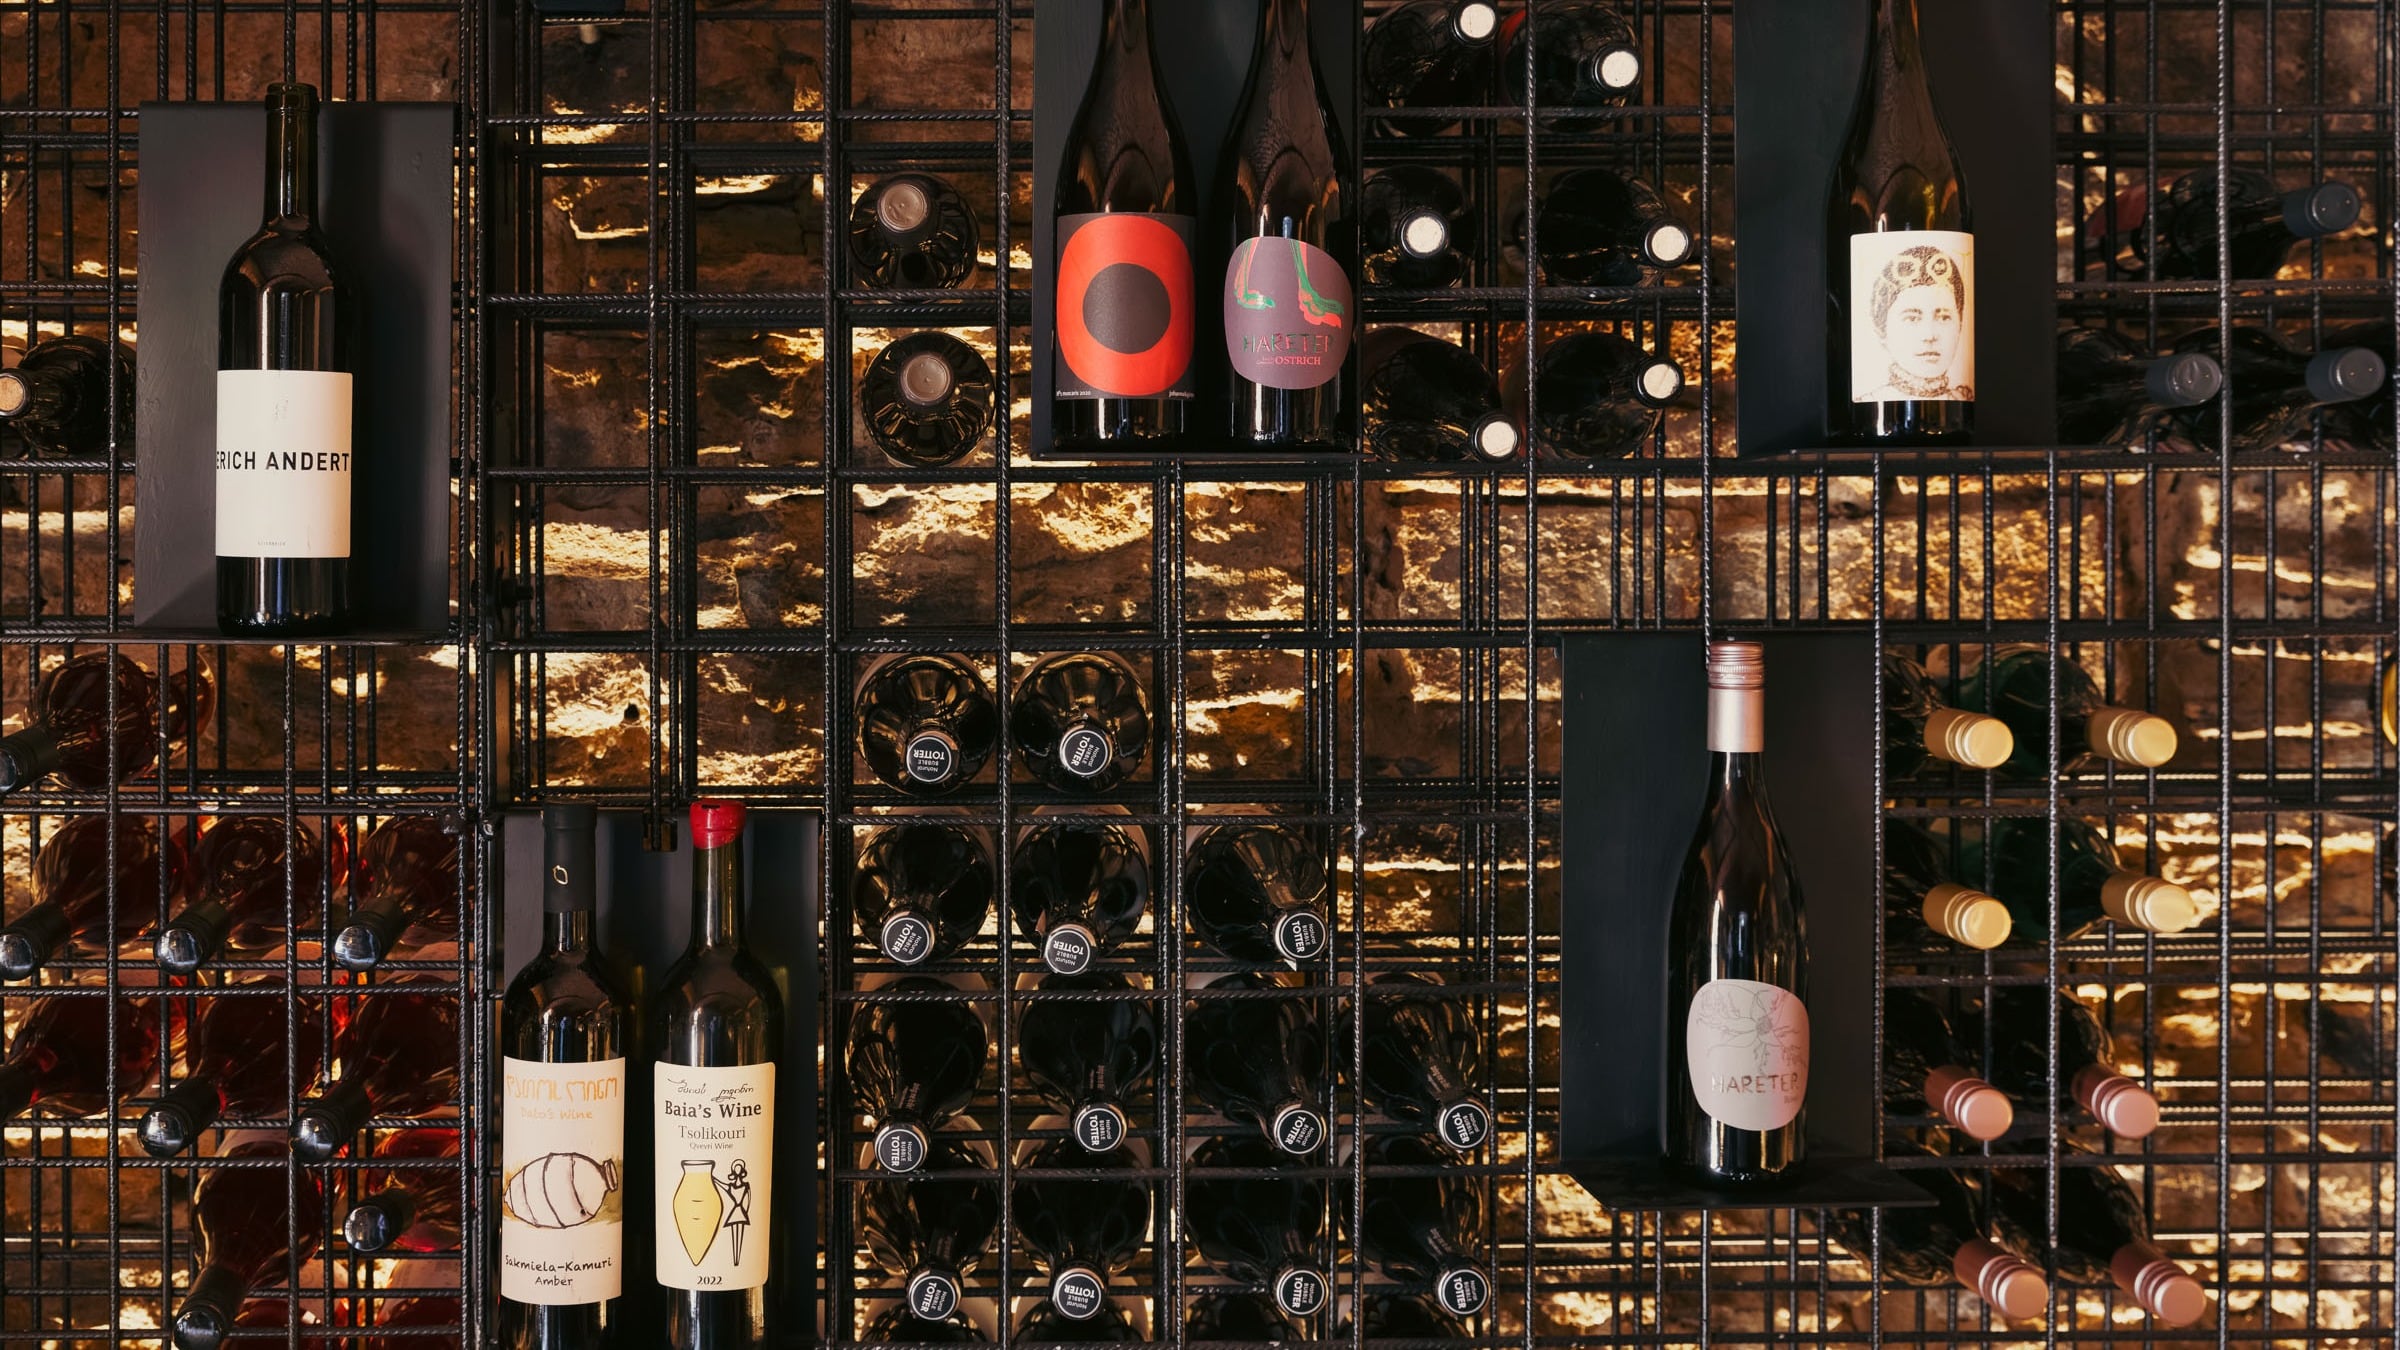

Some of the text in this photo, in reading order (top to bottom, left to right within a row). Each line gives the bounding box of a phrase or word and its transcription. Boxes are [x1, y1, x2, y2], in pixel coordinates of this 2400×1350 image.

[1243, 332, 1335, 353] HARETER
[1275, 356, 1321, 366] OSTRICH
[266, 451, 350, 471] ANDERT
[913, 749, 945, 760] TOTTER
[1071, 736, 1090, 766] TOTTER
[1082, 744, 1094, 764] BUBBLE
[1088, 746, 1100, 767] Natural
[892, 923, 914, 953] TOTTER
[902, 932, 916, 952] BUBBLE
[1292, 920, 1305, 953] TOTTER
[1302, 925, 1311, 945] BUBBLE
[1309, 923, 1317, 944] Natural
[908, 935, 922, 955] Natural
[1053, 940, 1084, 955] TOTTER
[1056, 950, 1077, 960] BUBBLE
[1055, 957, 1076, 966] Natural
[1712, 1072, 1800, 1094] HARETER
[664, 1100, 762, 1119] Baia's Wine
[1089, 1115, 1100, 1146] TOTTER
[1284, 1116, 1306, 1145] TOTTER
[1452, 1112, 1470, 1144] TOTTER
[1462, 1115, 1474, 1135] BUBBLE
[1468, 1112, 1480, 1132] Natural
[678, 1125, 746, 1140] Tsolikouri
[1296, 1124, 1309, 1143] BUBBLE
[1301, 1127, 1314, 1146] Natural
[891, 1136, 900, 1166] TOTTER
[505, 1254, 612, 1273] Sakmiela-Kamuri
[534, 1275, 574, 1287] Amber
[696, 1275, 723, 1286] 2022
[1470, 1280, 1478, 1301] Natural
[920, 1282, 937, 1312] TOTTER
[931, 1289, 942, 1309] BUBBLE
[1064, 1284, 1095, 1298] TOTTER
[1068, 1294, 1088, 1303] BUBBLE
[1292, 1277, 1303, 1308] TOTTER
[1453, 1277, 1466, 1309] TOTTER
[1464, 1281, 1472, 1302] BUBBLE
[937, 1291, 947, 1312] Natural
[1066, 1301, 1087, 1309] Natural
